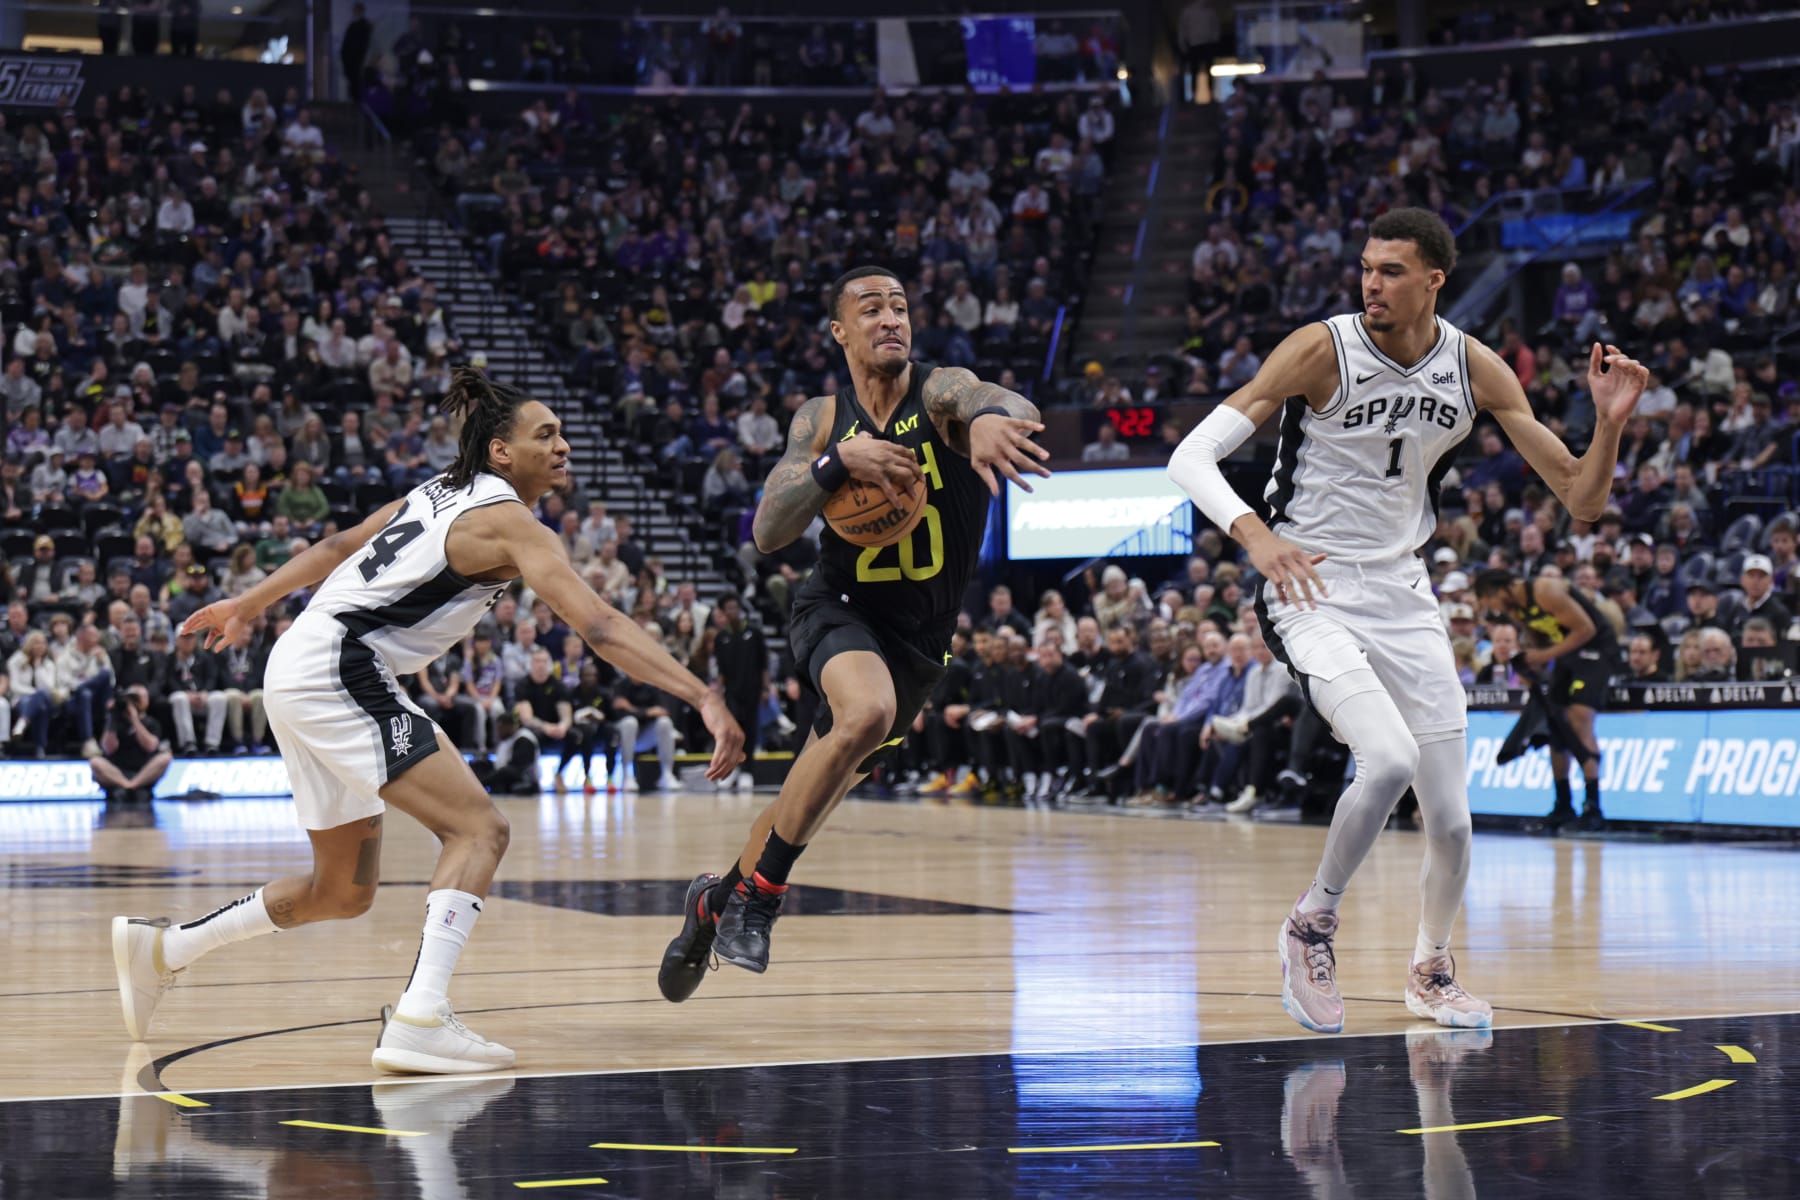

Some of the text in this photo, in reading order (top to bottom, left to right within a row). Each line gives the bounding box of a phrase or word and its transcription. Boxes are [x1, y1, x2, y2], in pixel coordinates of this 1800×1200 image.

[1432, 372, 1456, 384] Self.
[1343, 396, 1458, 433] SPURS
[1385, 438, 1403, 478] 1
[419, 478, 458, 519] ASSELL
[840, 507, 910, 536] Wilson
[357, 500, 426, 584] 4
[1477, 690, 1509, 702] DELTA
[1655, 687, 1696, 702] DELTA
[1722, 687, 1766, 701] DELTA
